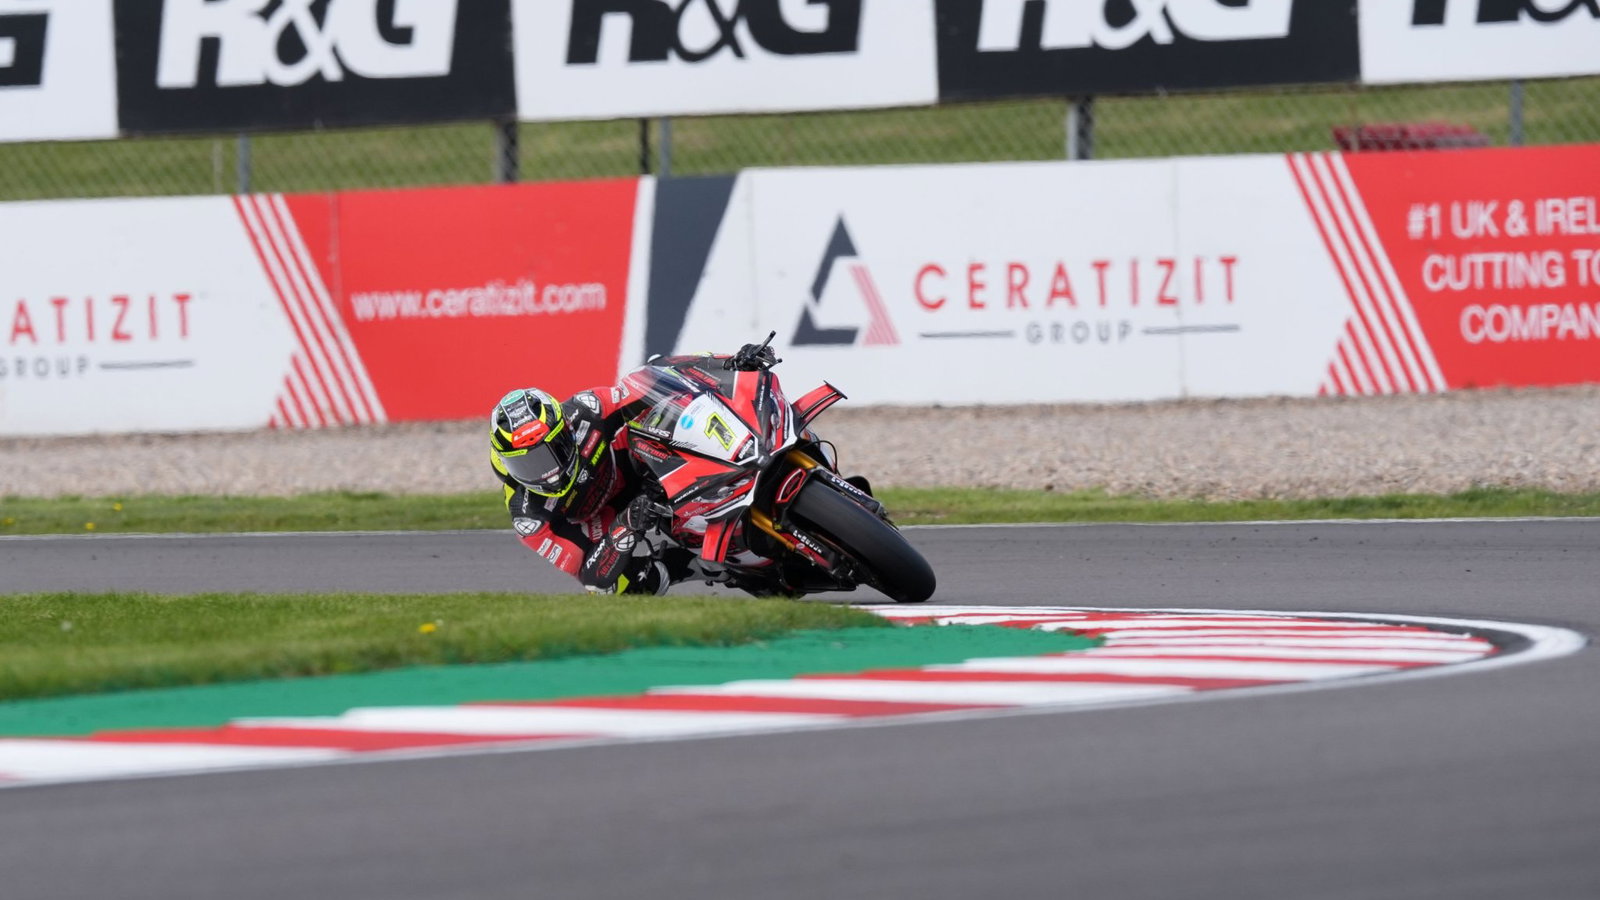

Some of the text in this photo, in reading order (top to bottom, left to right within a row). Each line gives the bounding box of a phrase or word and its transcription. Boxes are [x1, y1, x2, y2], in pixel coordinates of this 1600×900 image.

[1407, 203, 1441, 239] #1
[1451, 200, 1500, 238] UK
[1505, 199, 1529, 237] &
[914, 257, 1238, 311] CERATIZIT
[1422, 251, 1566, 292] CUTTING
[351, 279, 606, 321] www.ceratizit.com
[1025, 320, 1134, 344] GROUP
[704, 411, 737, 451] 1
[586, 538, 606, 569] IXON
[792, 529, 823, 554] PIRELLI
